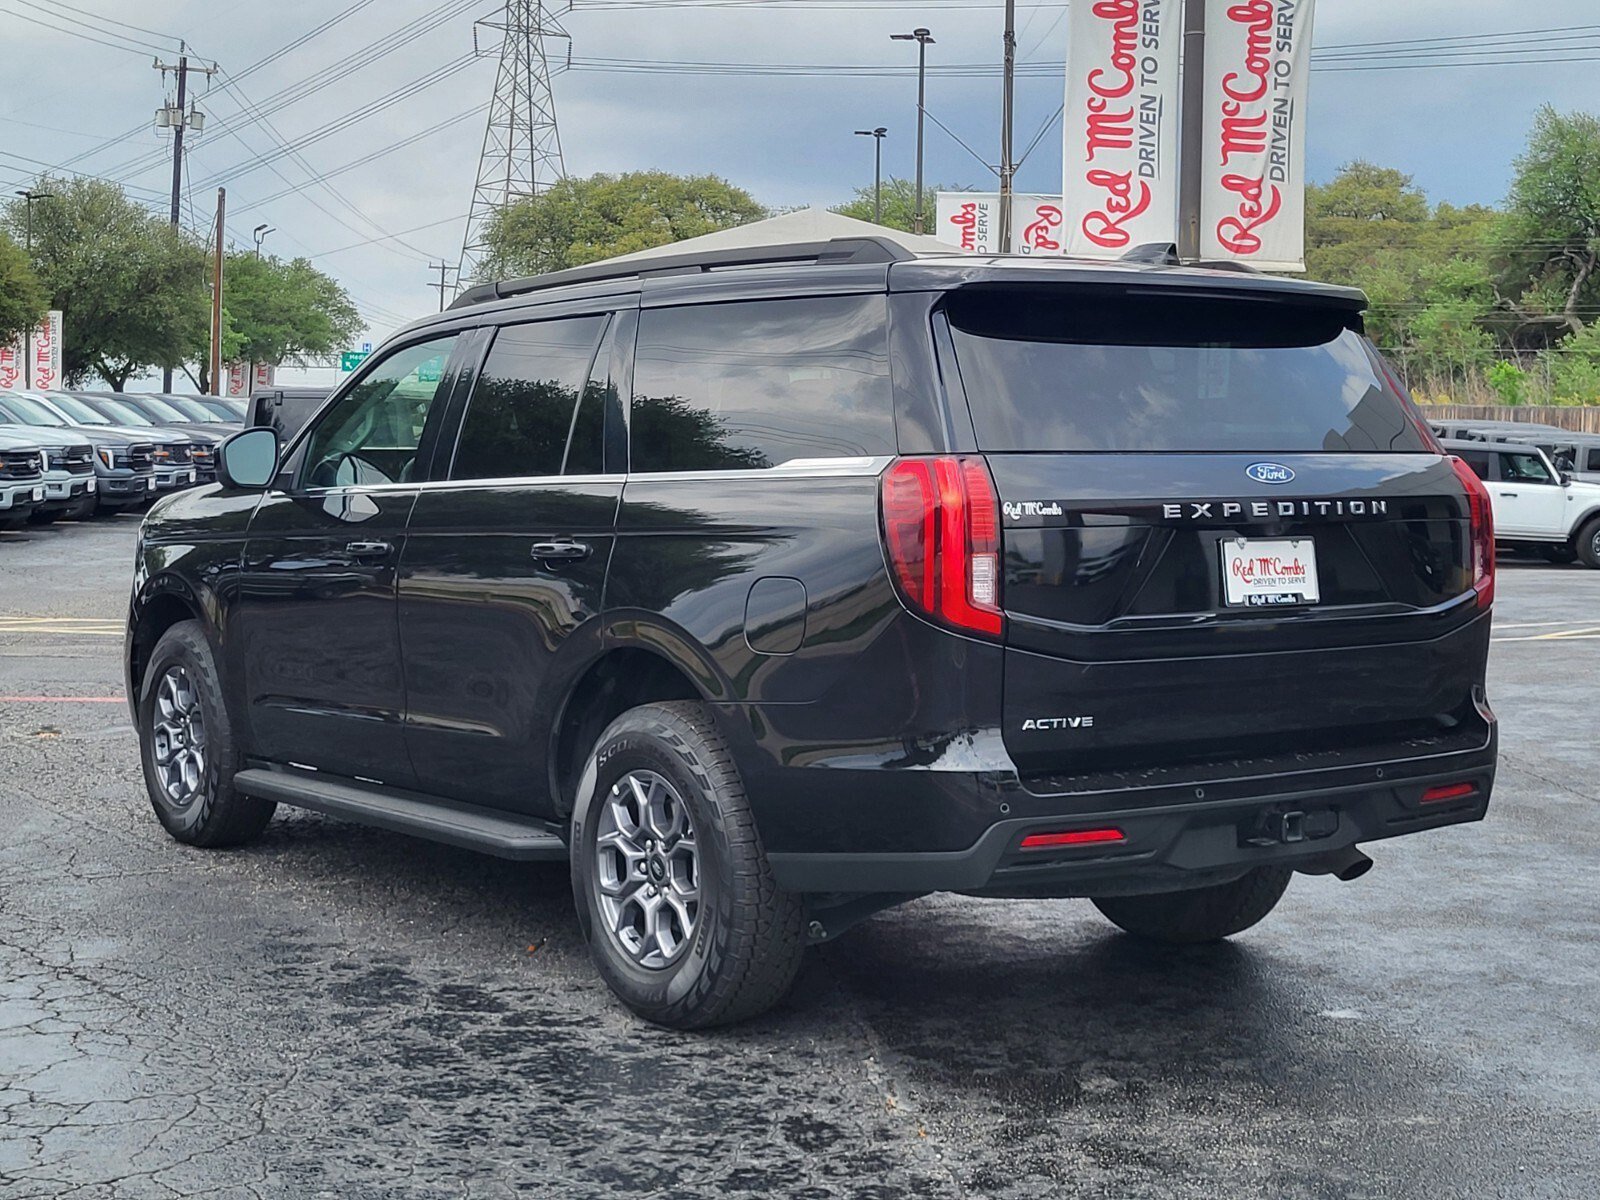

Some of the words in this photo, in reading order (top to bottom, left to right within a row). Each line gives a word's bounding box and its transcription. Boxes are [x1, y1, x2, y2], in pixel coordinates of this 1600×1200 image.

[1142, 0, 1160, 50] SERV
[1276, 0, 1295, 53] SERV
[1085, 0, 1139, 162] McComb
[1140, 56, 1158, 87] TO
[1220, 0, 1273, 166] McComb
[1274, 59, 1291, 90] TO
[1138, 94, 1157, 179] DRIVEN
[1269, 98, 1289, 183] DRIVEN
[977, 202, 988, 242] SERVE
[1024, 205, 1063, 250] Red
[1082, 169, 1151, 248] Red
[1217, 174, 1281, 254] Red
[1003, 502, 1021, 520] Red
[1163, 500, 1387, 519] EXPEDITION
[1232, 557, 1254, 584] Red
[1255, 557, 1305, 576] McCombs
[1253, 577, 1276, 586] DRIVEN
[1277, 577, 1287, 585] TO
[1288, 576, 1306, 584] SERVE
[1022, 716, 1093, 731] ACTIVE
